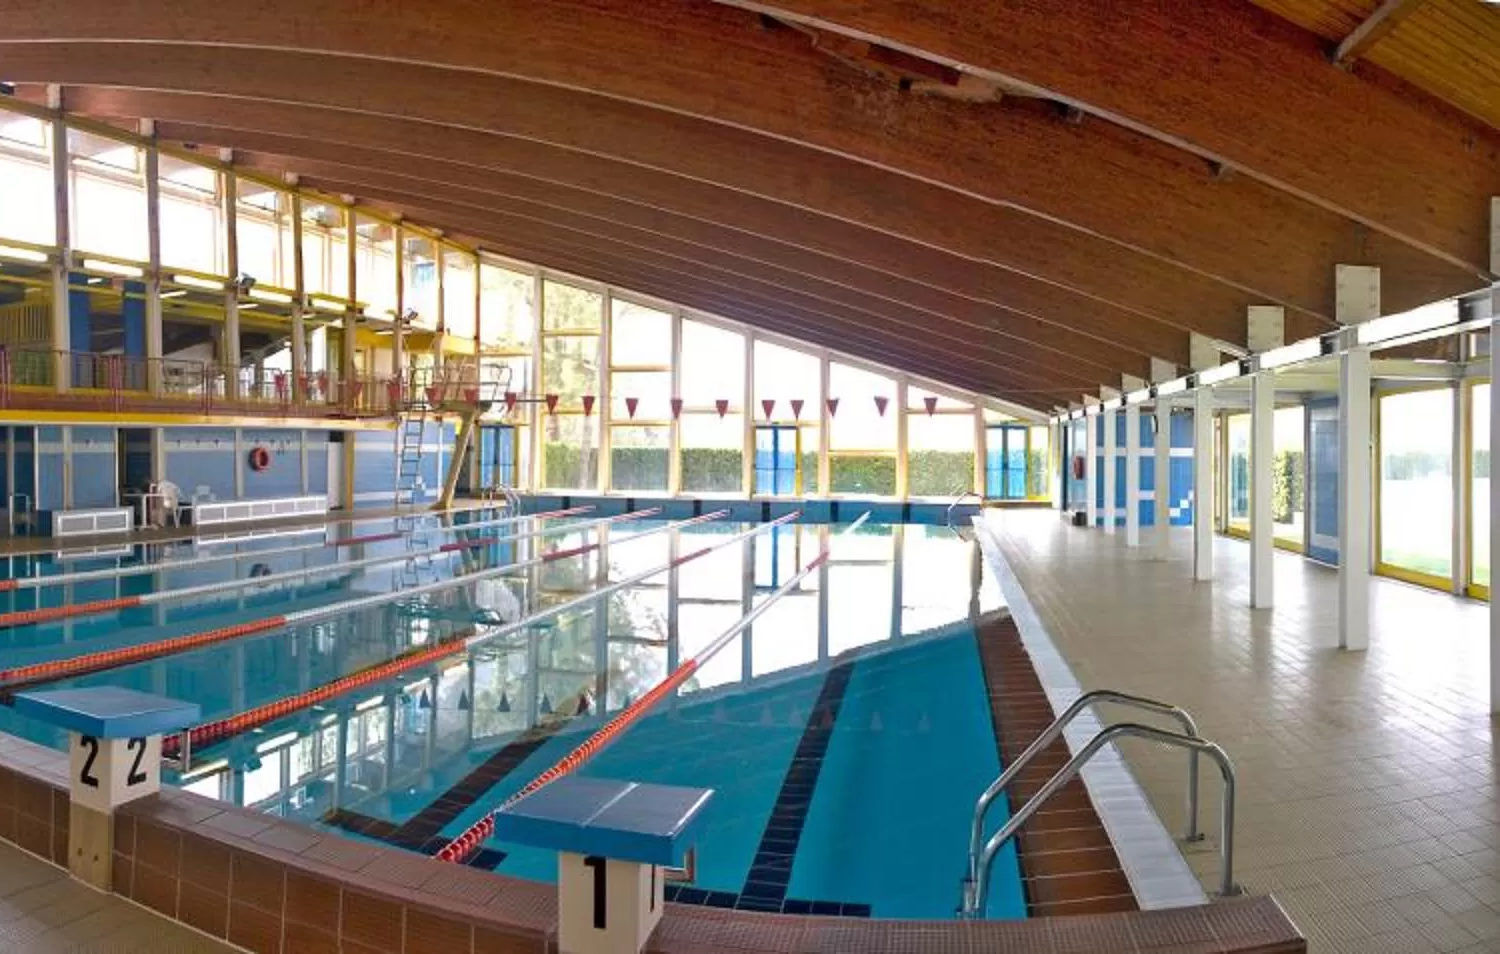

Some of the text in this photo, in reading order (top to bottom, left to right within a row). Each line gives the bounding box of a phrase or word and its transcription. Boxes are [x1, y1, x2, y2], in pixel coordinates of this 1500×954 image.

[81, 736, 99, 788] 2
[127, 737, 147, 787] 2
[583, 856, 607, 929] 1
